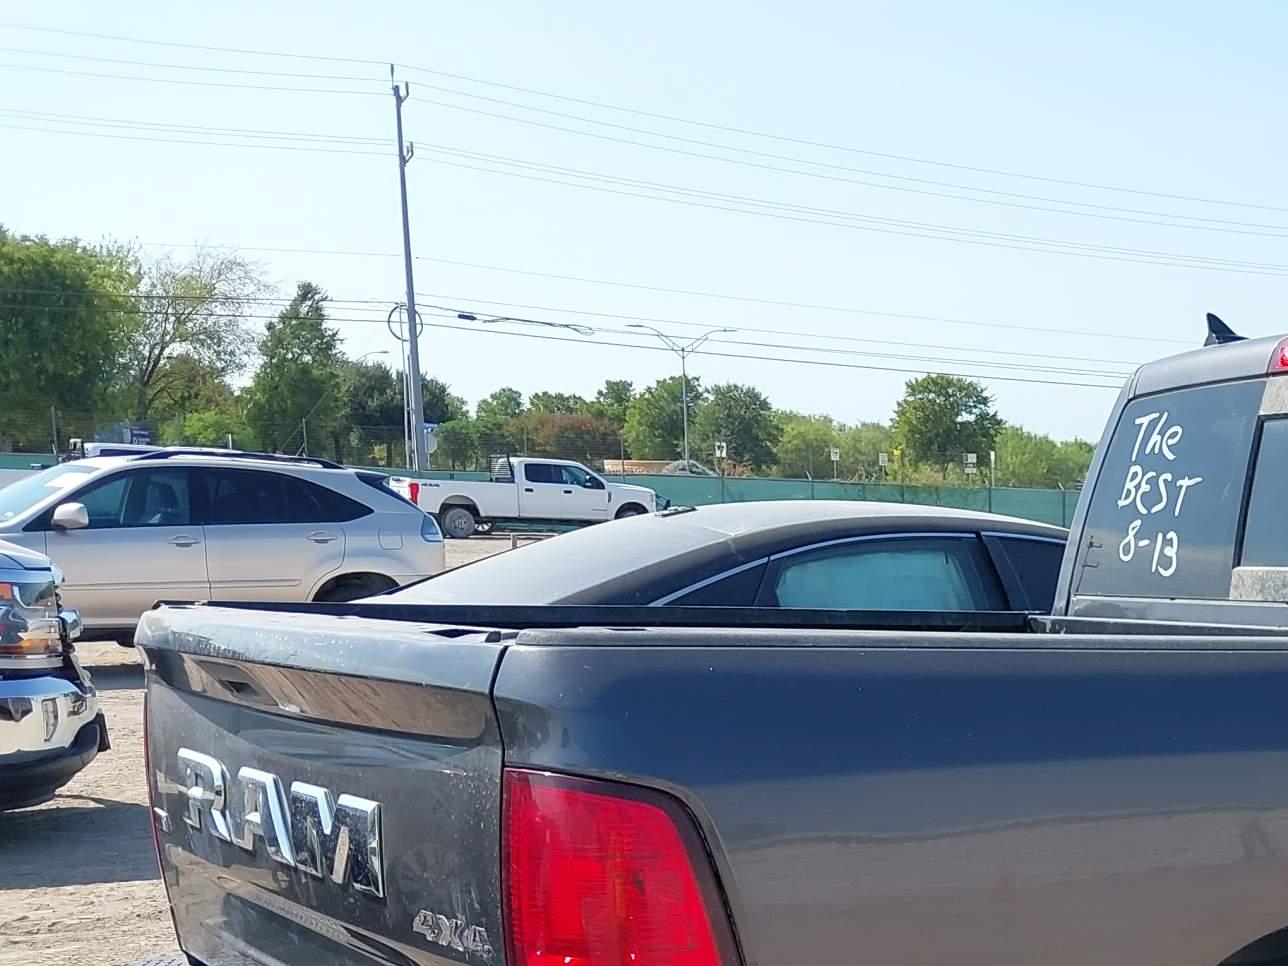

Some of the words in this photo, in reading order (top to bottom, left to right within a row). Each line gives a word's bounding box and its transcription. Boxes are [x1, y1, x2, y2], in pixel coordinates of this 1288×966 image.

[1132, 411, 1183, 461] The
[1117, 464, 1203, 516] BEST
[1119, 519, 1179, 577] 8-13
[177, 746, 384, 899] RAM
